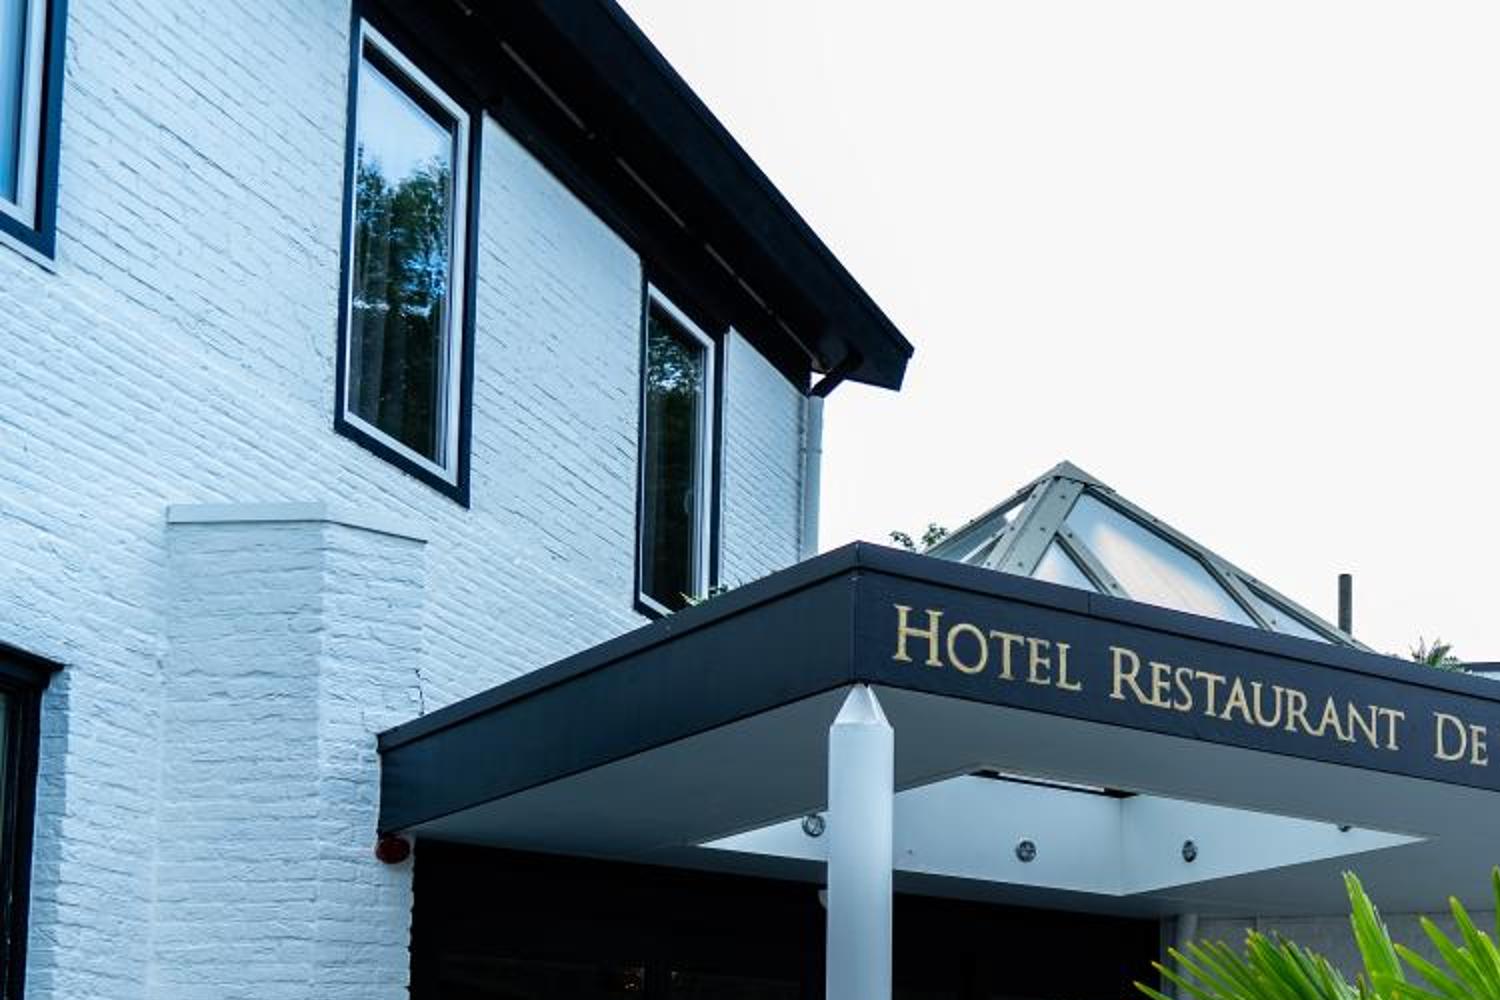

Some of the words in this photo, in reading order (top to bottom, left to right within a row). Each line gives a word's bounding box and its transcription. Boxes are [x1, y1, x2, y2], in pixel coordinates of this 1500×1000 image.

[892, 603, 1082, 691] HOTEL
[1108, 645, 1405, 751] RESTAURANT
[1433, 712, 1488, 766] DE
